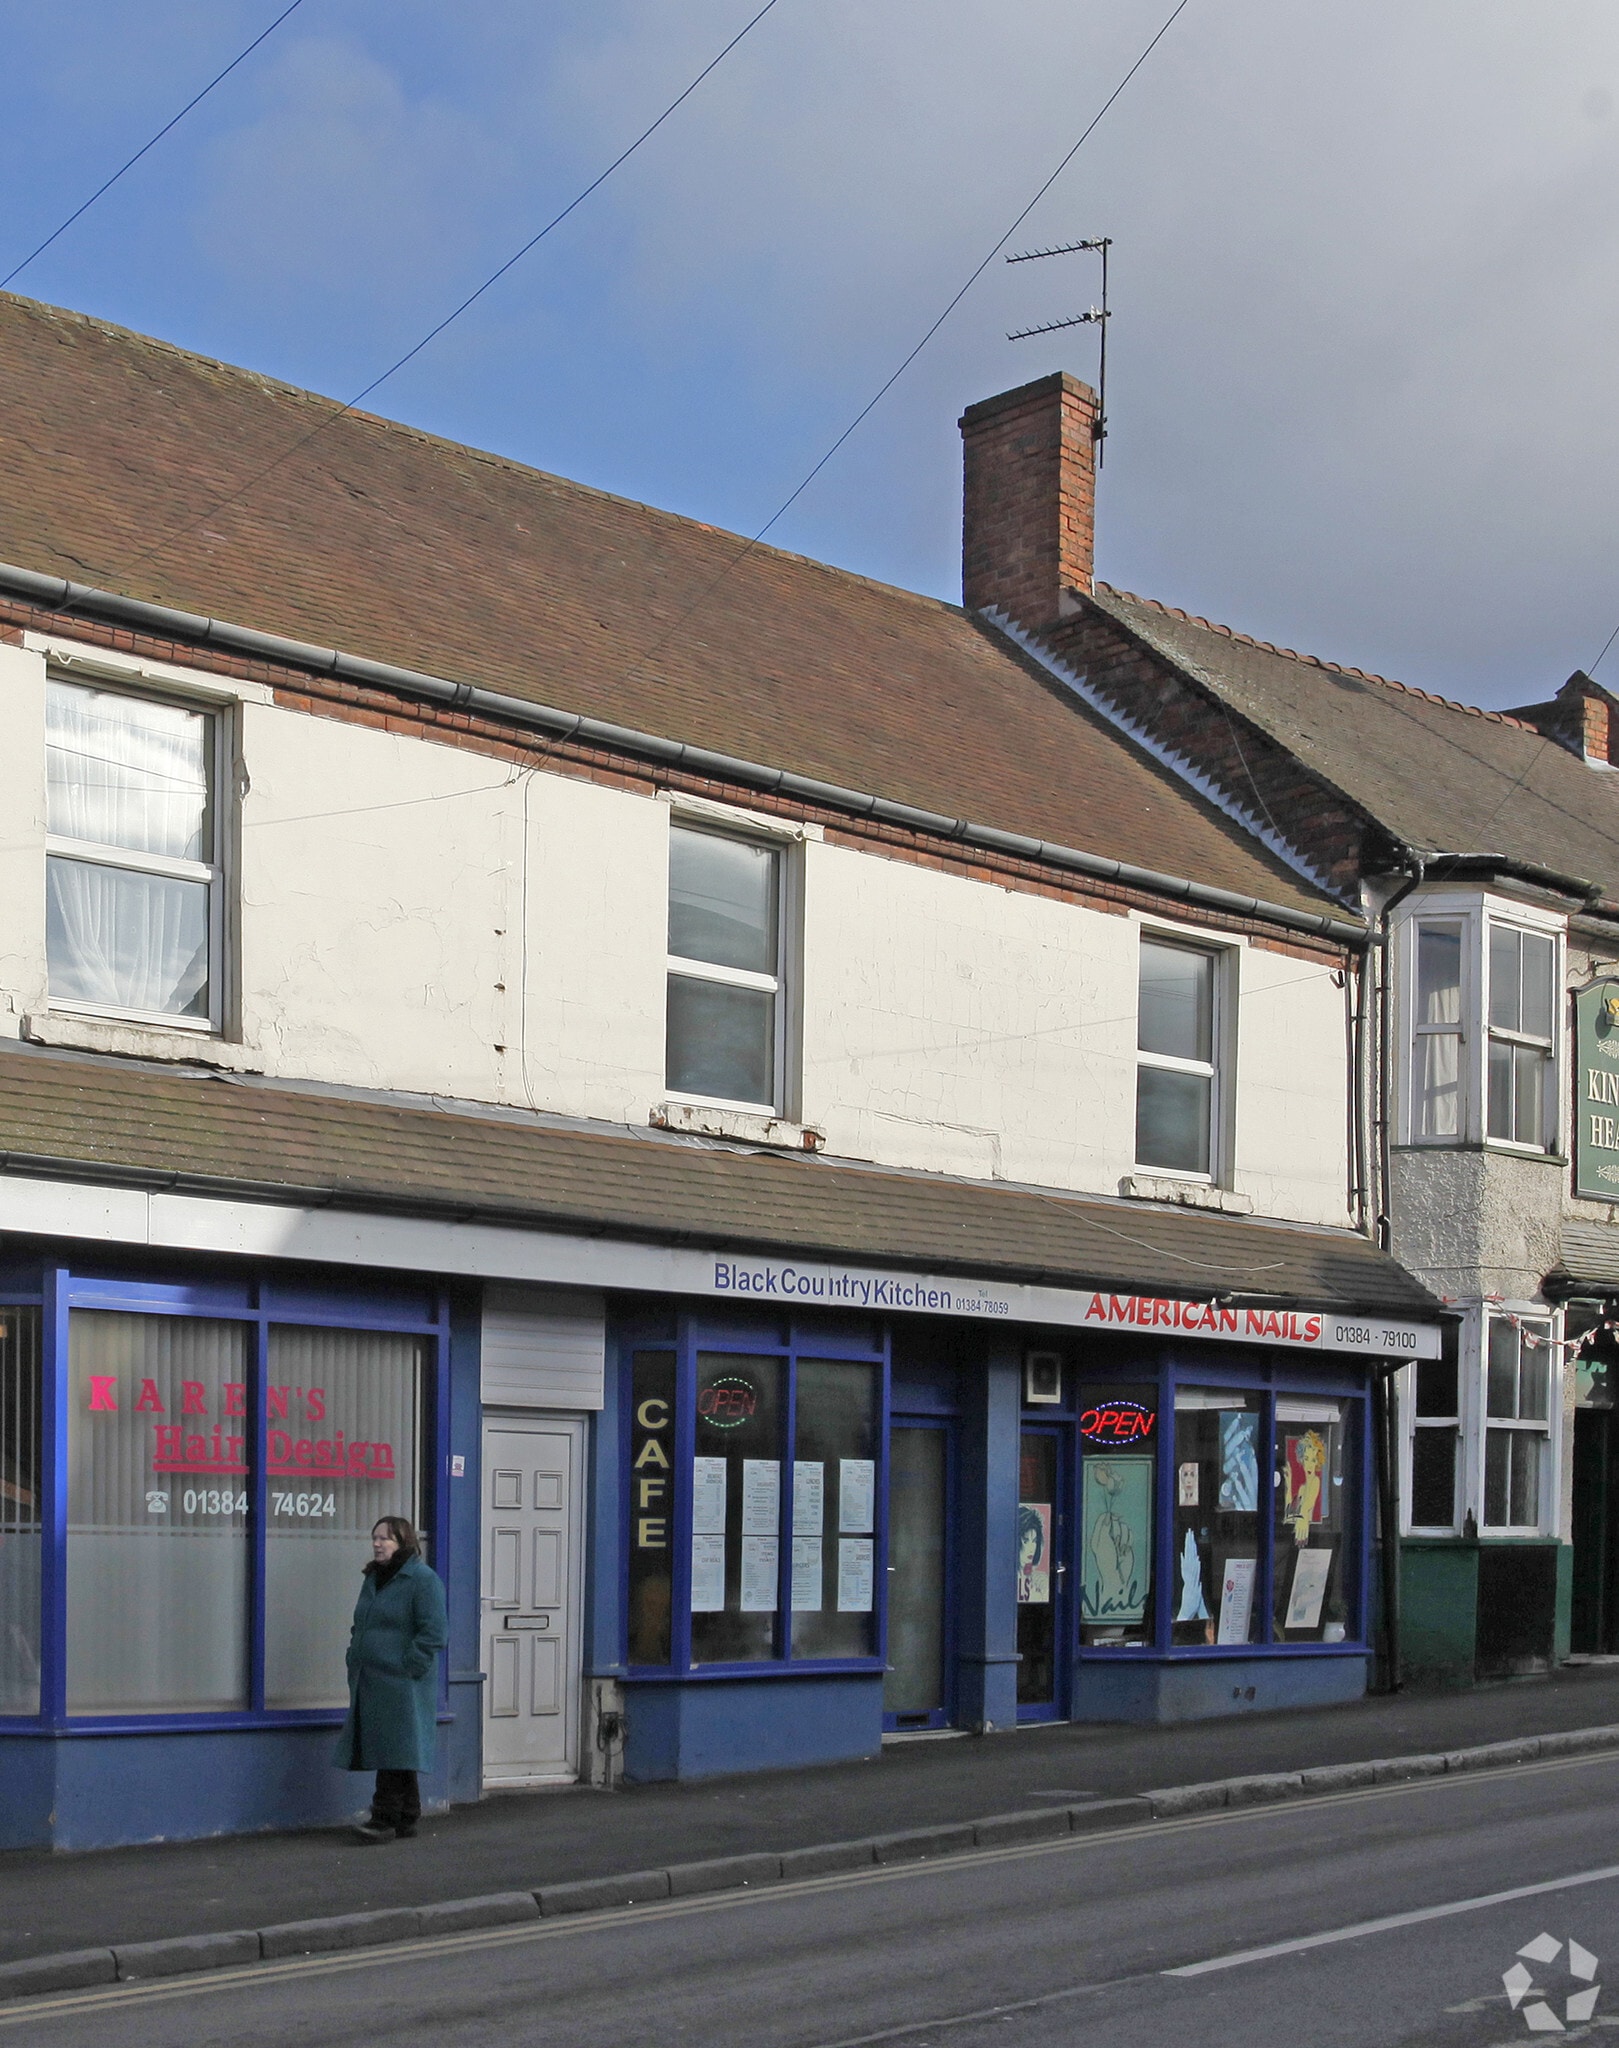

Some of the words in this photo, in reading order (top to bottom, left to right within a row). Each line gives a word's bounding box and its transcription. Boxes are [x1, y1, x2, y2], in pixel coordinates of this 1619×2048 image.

[955, 1297, 981, 1312] 01384
[984, 1300, 1009, 1315] 78059
[1084, 1292, 1238, 1333] AMERICAN
[1245, 1309, 1321, 1343] NAILS
[1335, 1325, 1370, 1345] 01384
[1382, 1330, 1417, 1349] 79100
[87, 1374, 326, 1422] KAREN'S
[697, 1388, 758, 1416] OPEN
[1080, 1409, 1156, 1437] OPEN
[153, 1424, 246, 1465] Hair
[266, 1429, 396, 1478] Design
[634, 1398, 670, 1549] CAFE
[183, 1489, 249, 1515] 01384
[272, 1492, 336, 1517] 74624
